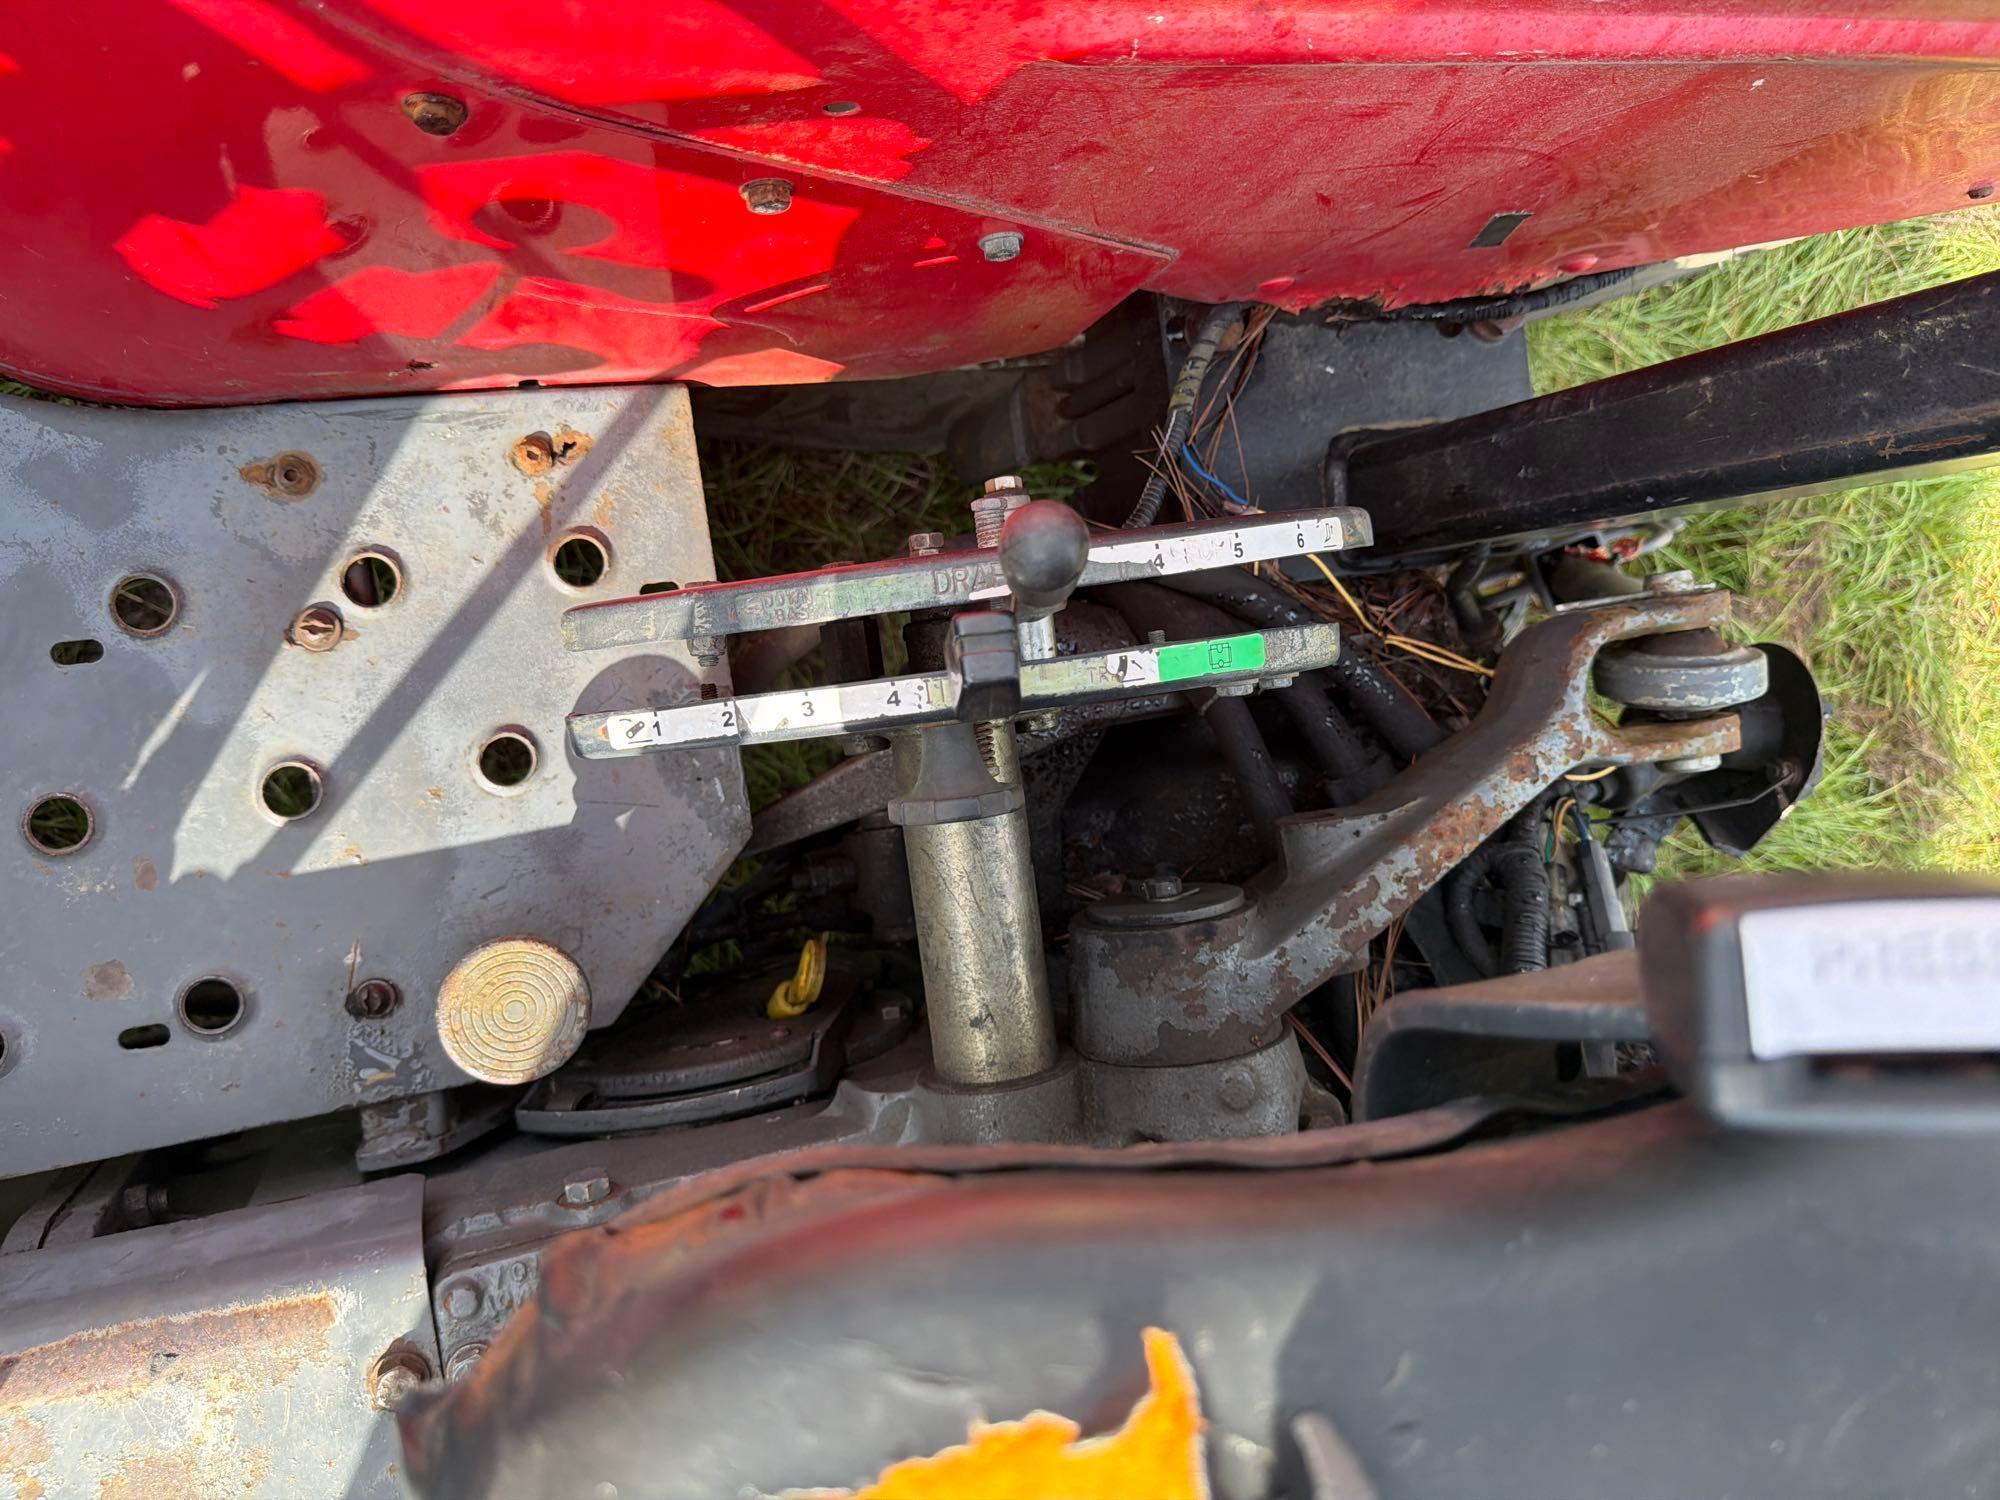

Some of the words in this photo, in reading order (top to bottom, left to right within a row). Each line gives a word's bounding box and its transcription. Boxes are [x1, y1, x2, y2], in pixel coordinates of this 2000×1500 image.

[1153, 553, 1166, 571] 4
[1233, 542, 1245, 559] 5
[1296, 532, 1305, 549] 6
[652, 720, 662, 737] 1
[721, 710, 735, 727] 2
[801, 700, 815, 717] 3
[886, 689, 902, 707] 4
